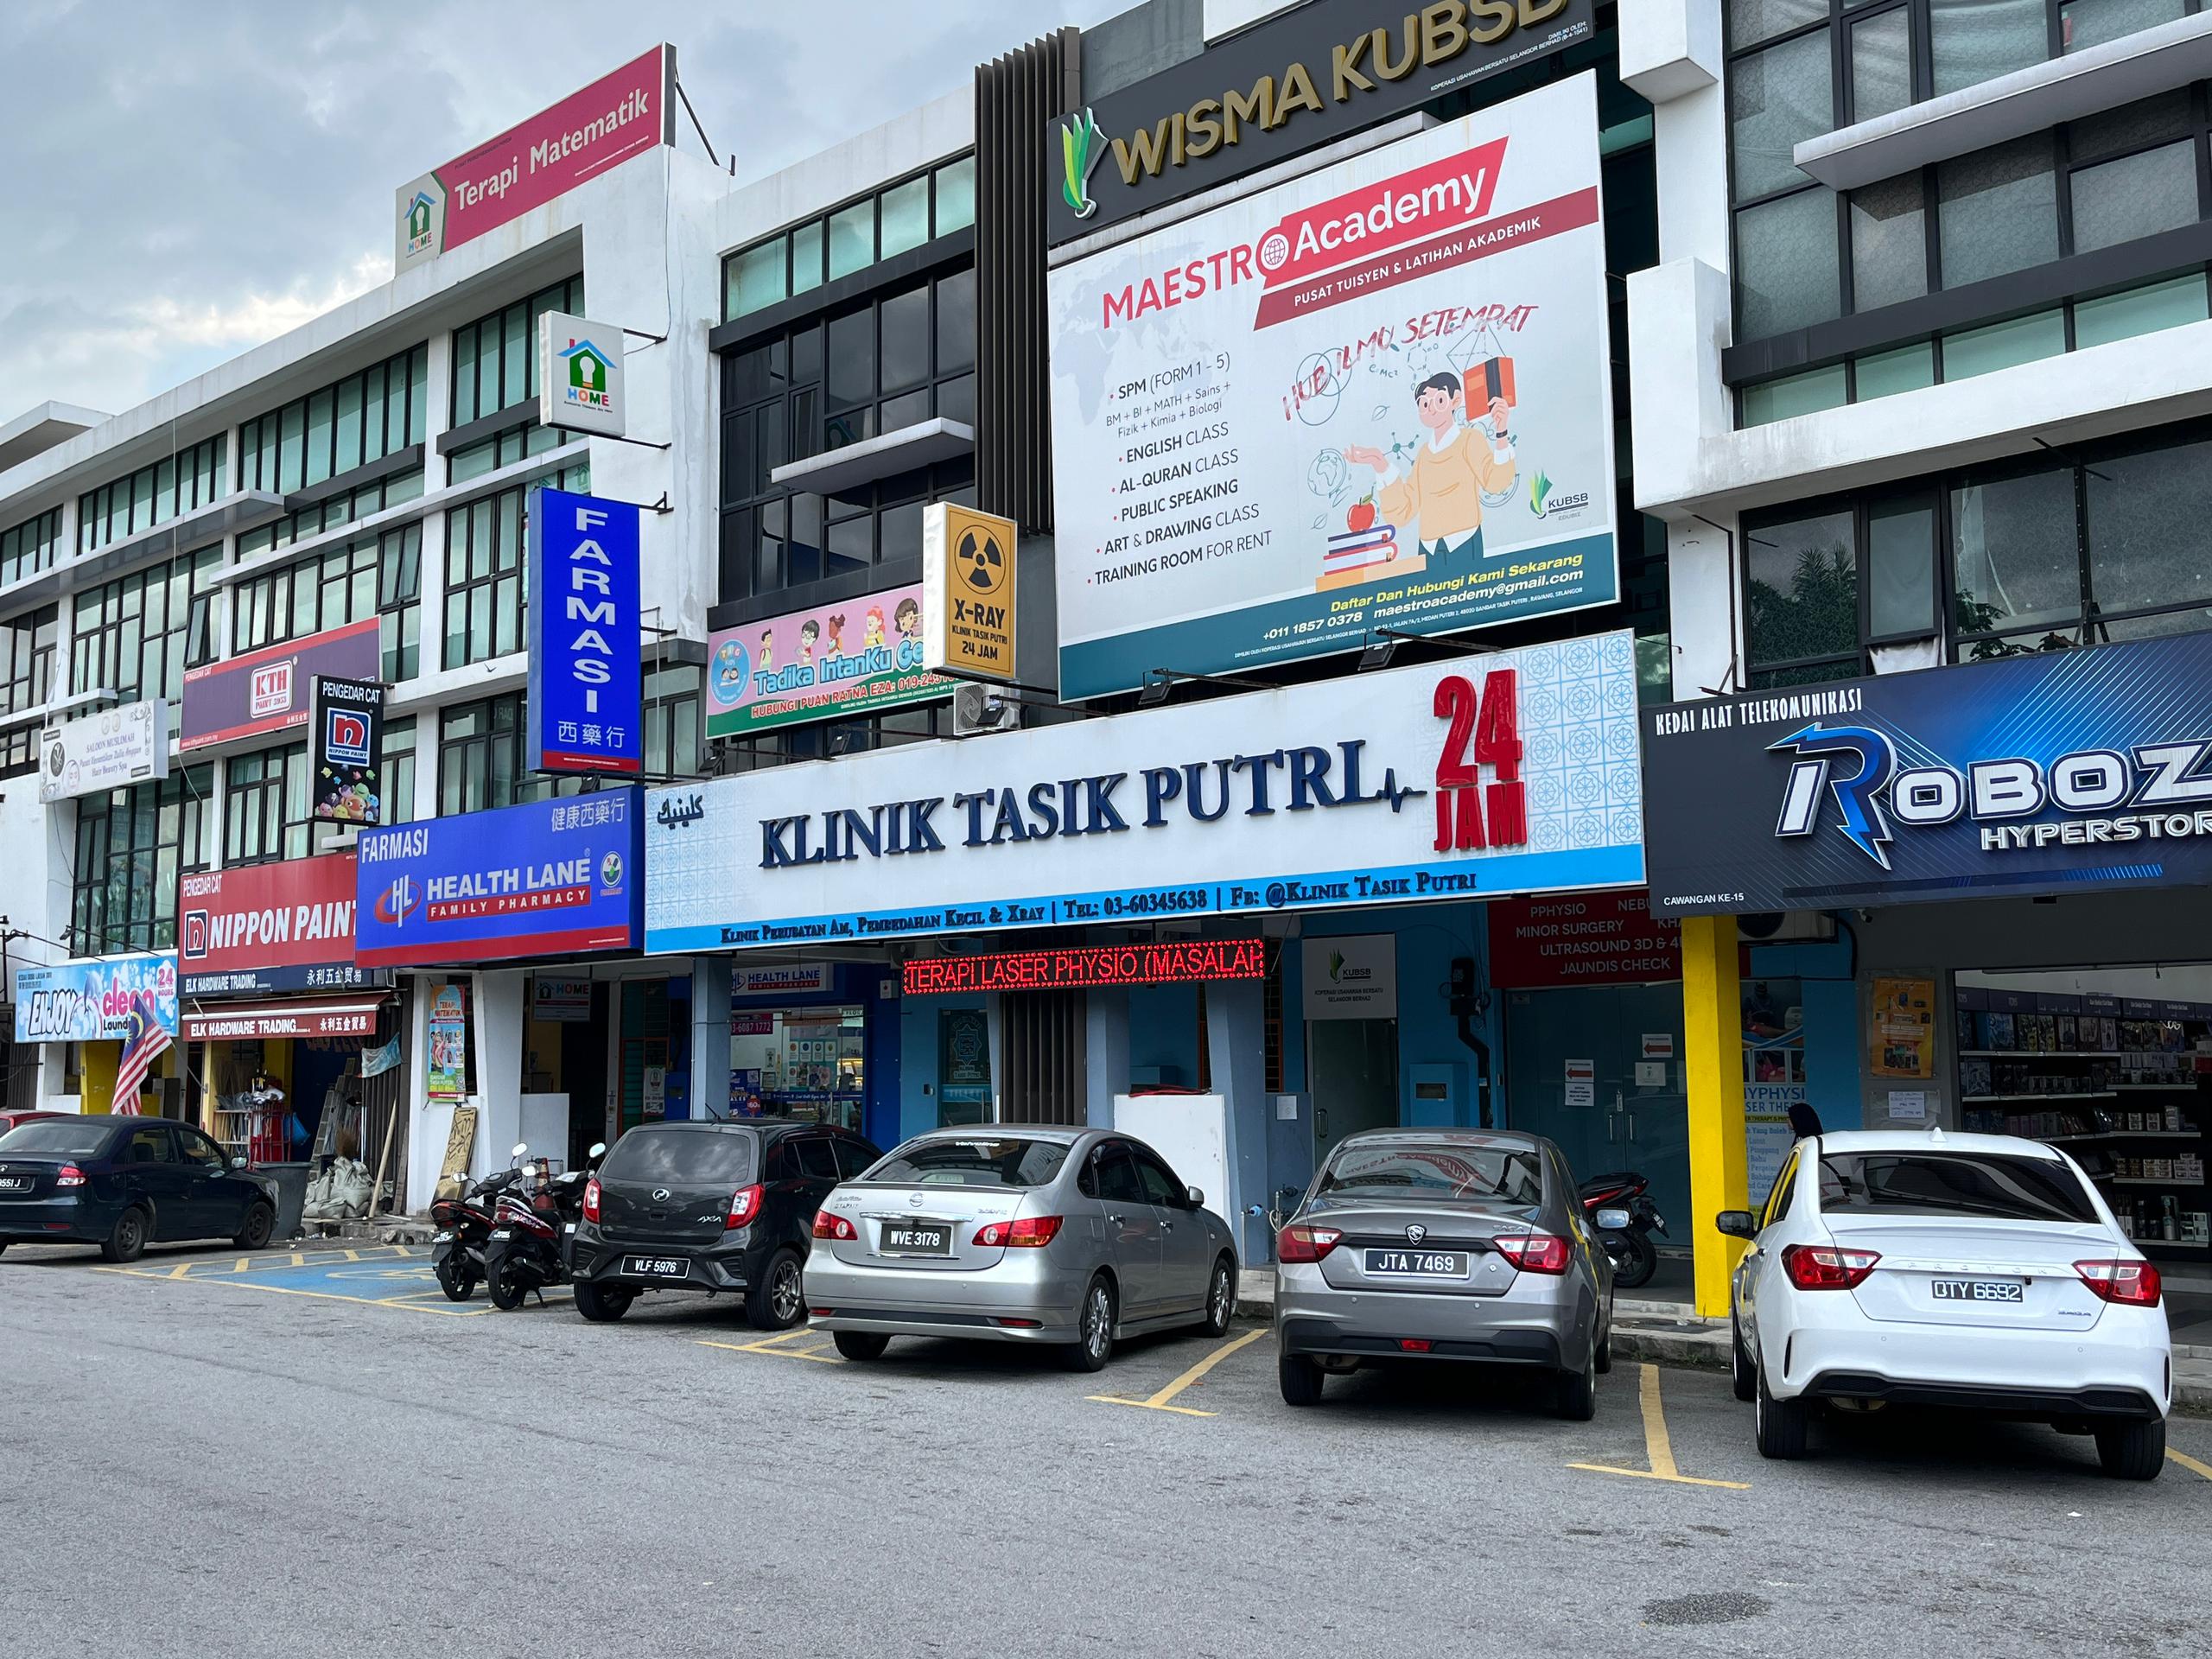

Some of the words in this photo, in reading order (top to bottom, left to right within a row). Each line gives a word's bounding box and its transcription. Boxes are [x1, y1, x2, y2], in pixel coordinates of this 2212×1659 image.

[1485, 58, 1509, 71] BERSATU
[1509, 46, 1539, 61] SELANGOR
[1539, 37, 1561, 51] BERHAD
[1111, 62, 1323, 185] WISMA
[454, 156, 518, 211] Terapi
[530, 88, 649, 175] Matematik
[1293, 166, 1486, 263] Academy
[408, 232, 433, 253] HOME
[1294, 283, 1332, 307] PUSAT
[1336, 267, 1389, 296] TUISYEN
[1393, 261, 1402, 276] &
[1406, 242, 1463, 271] LATIHAN
[1467, 217, 1542, 251] AKADEMIK
[1118, 378, 1147, 400] SPM
[1149, 364, 1193, 395] (FORM
[1195, 361, 1202, 376] 1
[1217, 352, 1231, 372] 5)
[1282, 366, 1331, 422] HUB
[1337, 325, 1394, 376] ILMU
[1402, 303, 1540, 344] SETEMPAT
[568, 387, 609, 407] HOME
[1106, 413, 1122, 426] BM
[1133, 408, 1142, 419] BI
[1154, 395, 1183, 415] MATH
[1195, 385, 1221, 403] Sains
[1118, 423, 1139, 438] Fizik
[1150, 413, 1177, 429] Kimia
[1189, 399, 1222, 419] Biologi
[1127, 435, 1183, 463] ENGLISH
[1185, 422, 1229, 446] CLASS
[1119, 461, 1192, 494] AL-QURAN
[1195, 448, 1239, 473] CLASS
[1122, 498, 1166, 522] PUBLIC
[1169, 479, 1238, 509] SPEAKING
[1548, 493, 1588, 508] KUBSB
[1104, 536, 1130, 555] ART
[1133, 534, 1143, 547] &
[1146, 516, 1211, 545] DRAWING
[1215, 504, 1260, 527] CLASS
[1095, 558, 1158, 585] TRAINING
[1160, 547, 1204, 570] ROOM
[1206, 540, 1234, 559] FOR
[1236, 530, 1273, 552] RENT
[1331, 595, 1373, 613] Daftar
[1376, 588, 1403, 603] Dan
[1407, 575, 1465, 598] Hubungi
[1468, 570, 1505, 585] Kami
[1509, 554, 1583, 577] Sekarang
[566, 506, 615, 714] FARMASI
[954, 598, 1006, 630] X-RAY
[1263, 626, 1289, 640] +011
[1293, 619, 1325, 634] 1857
[1327, 612, 1363, 627] 0378
[1374, 569, 1584, 620] maestroacademy@gmail.com
[952, 625, 971, 638] KLINIK
[972, 628, 988, 641] TASIK
[990, 632, 1007, 645] PUTRI
[962, 640, 975, 654] 24
[976, 644, 998, 660] JAM
[185, 669, 204, 682] PENGEDAR
[204, 667, 213, 677] CAT
[256, 669, 287, 697] KTH
[753, 663, 815, 696] Tadika
[819, 646, 893, 683] IntanKu
[322, 681, 364, 702] PENGEDAR
[365, 689, 380, 704] CAT
[751, 702, 798, 719] HUBUNGI
[801, 694, 831, 710] PUAN
[833, 686, 868, 702] RATNA
[871, 681, 895, 696] EZA:
[1656, 711, 1695, 735] KEDAI
[1701, 707, 1732, 728] ALAT
[1738, 689, 1863, 725] TELEKOMUNIKASI
[558, 720, 626, 750] 西藥行
[1433, 669, 1522, 788] 24
[328, 747, 349, 757] NIPPON
[350, 750, 367, 759] PAINT
[759, 797, 944, 868] KLINIK
[954, 772, 1129, 847] TASIK
[1140, 740, 1382, 828] PUTRI
[1764, 721, 2212, 871] ROBOZ
[551, 797, 626, 833] 健康西藥行
[1433, 781, 1527, 852] JAM
[361, 828, 429, 864] FARMASI
[182, 876, 212, 897] PENGEDAR
[211, 874, 222, 893] CAT
[427, 866, 519, 902] HEALTH
[526, 857, 591, 890] LANE
[429, 899, 488, 919] FAMILY
[499, 889, 588, 911] PHARMACY
[721, 926, 760, 944] KLINIK
[761, 922, 826, 941] PERUBATAN
[858, 914, 941, 934] PEMBEDAHAN
[945, 909, 985, 927] KECIL
[988, 907, 1003, 924] &
[1007, 904, 1045, 922] XRAY
[1065, 899, 1098, 920] TEL:
[1103, 889, 1207, 916] 03-60345638
[1230, 886, 1260, 907] FB:
[1265, 880, 1349, 909] @KLINIK
[1354, 875, 1410, 898] TASIK
[1415, 871, 1477, 892] PUTRI
[1530, 902, 1586, 918] PPHYSIO
[1663, 893, 1716, 906] CAWANGAN
[1718, 892, 1745, 903] KE-15
[209, 907, 291, 950] NIPPON
[1516, 923, 1558, 938] MINOR
[1561, 918, 1624, 937] SURGERY
[1540, 938, 1630, 957] ULTRASOUND
[1634, 938, 1655, 951] 3D
[1656, 938, 1668, 950] &
[158, 966, 174, 987] 24
[748, 971, 789, 982] HEALTH
[792, 969, 820, 980] LANE
[906, 962, 976, 990] TERAPI
[981, 958, 1047, 985] LASER
[1056, 950, 1137, 982] PHYSIO
[1342, 968, 1371, 976] KUBSB
[1560, 958, 1618, 976] JAUNDIS
[1621, 957, 1671, 973] CHECK
[185, 977, 197, 993] ELK
[198, 975, 228, 992] HARDWARE
[229, 973, 257, 990] TRADING
[556, 983, 588, 995] HOME
[29, 988, 79, 1036] ENJOY
[103, 1017, 130, 1031] Laund
[191, 1022, 207, 1037] ELK
[208, 1020, 255, 1036] HARDWARE
[257, 1018, 296, 1033] TRADING
[755, 1021, 771, 1032] 1772
[1745, 1102, 1765, 1112] SER
[15, 1178, 21, 1188] J
[890, 1230, 912, 1245] WVE
[914, 1231, 941, 1247] 3178
[634, 1259, 652, 1272] VLF
[654, 1261, 677, 1274] 5976
[1377, 1252, 1408, 1271] JTA
[1414, 1254, 1455, 1273] 7469
[1974, 1282, 2021, 1301] 6692
